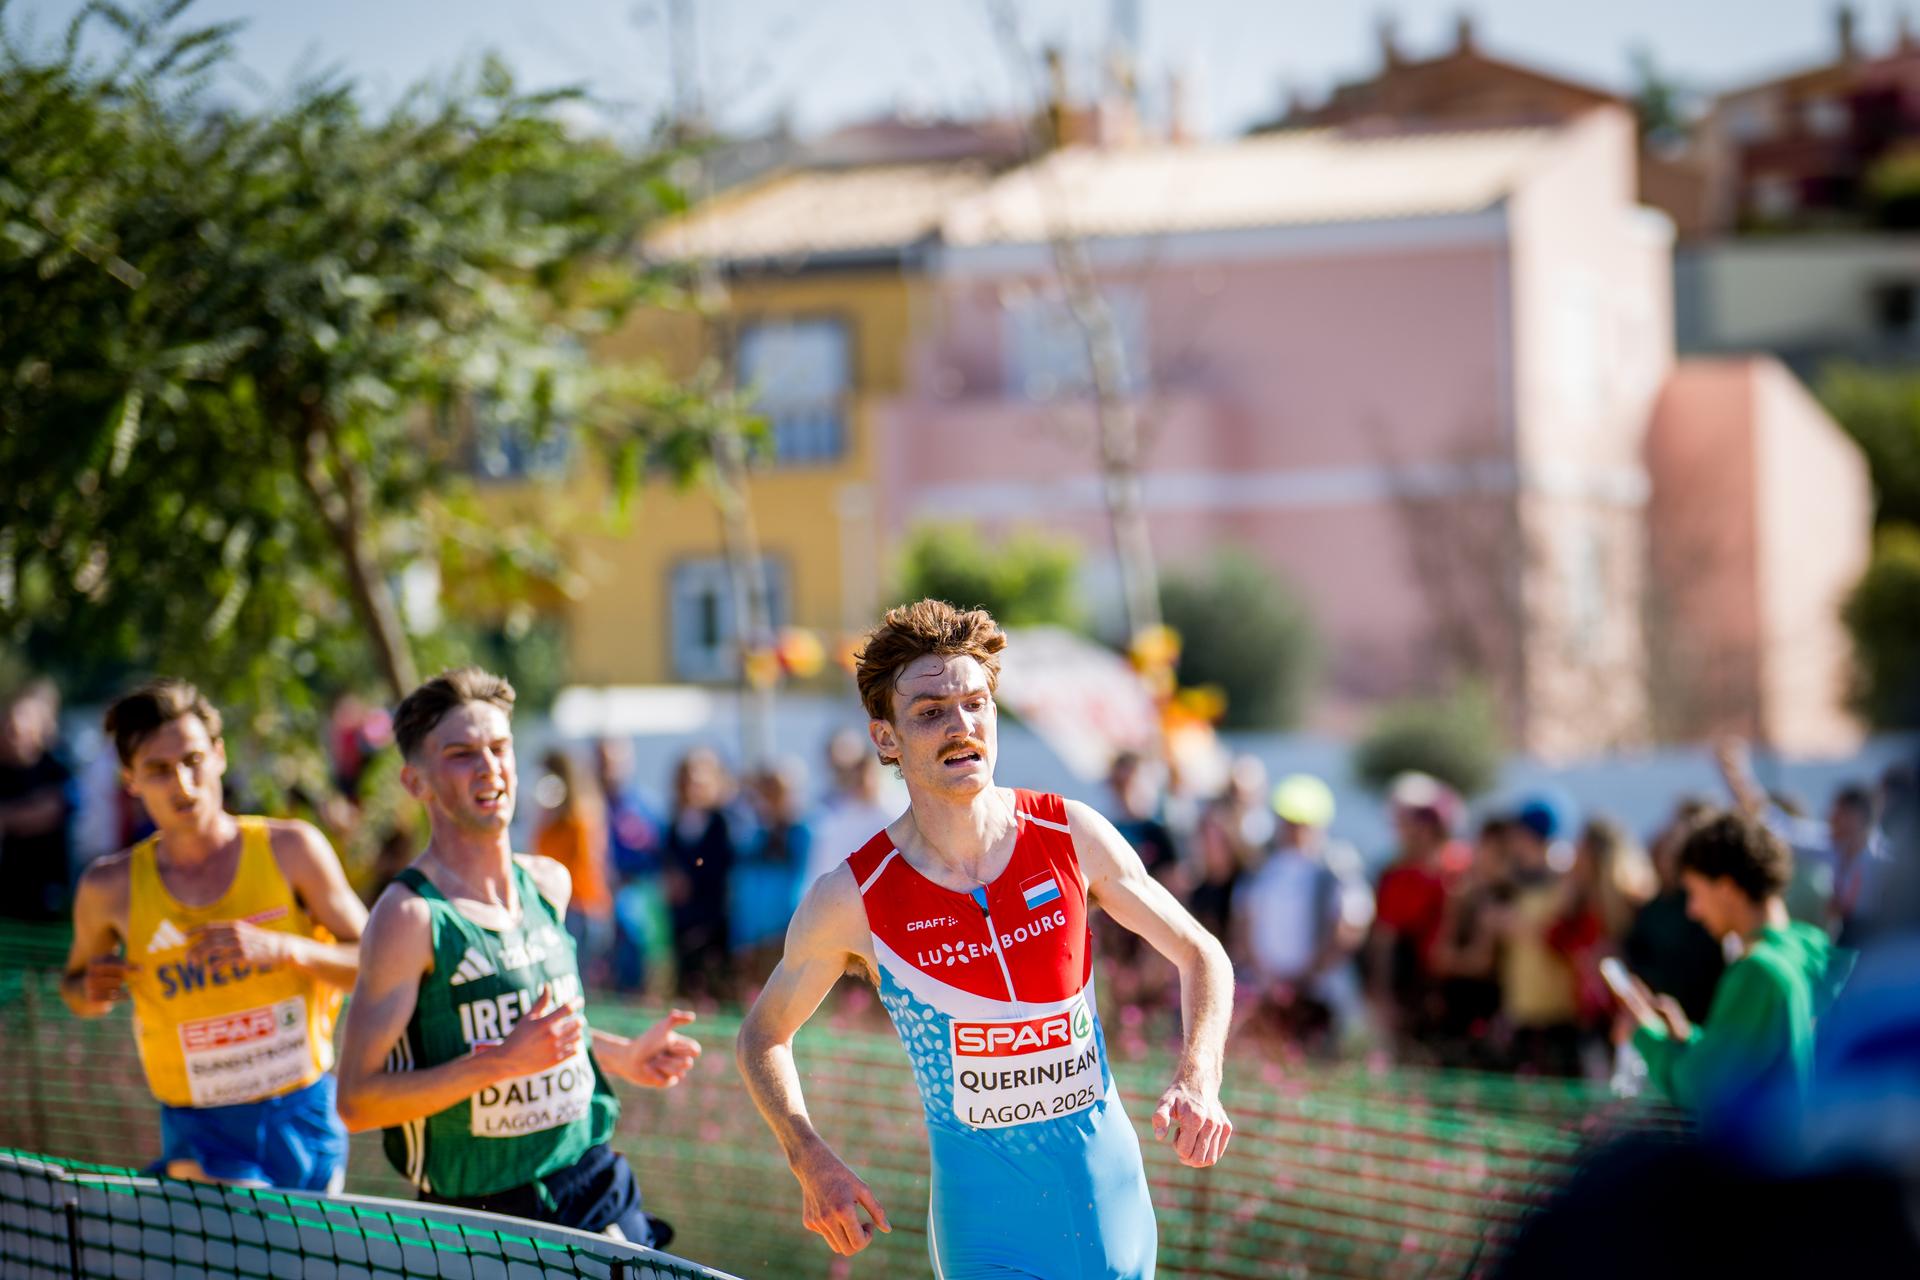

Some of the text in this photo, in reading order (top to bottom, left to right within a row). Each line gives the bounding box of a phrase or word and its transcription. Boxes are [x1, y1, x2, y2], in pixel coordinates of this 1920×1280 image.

[906, 917, 946, 932] CRAFT
[917, 909, 1067, 967] LUXEMBOURG
[956, 1021, 1069, 1053] SPAR
[959, 1046, 1097, 1093] QUERINJEAN
[485, 1110, 551, 1132] LAGOA
[969, 1085, 1096, 1124] LAGOA 2025
